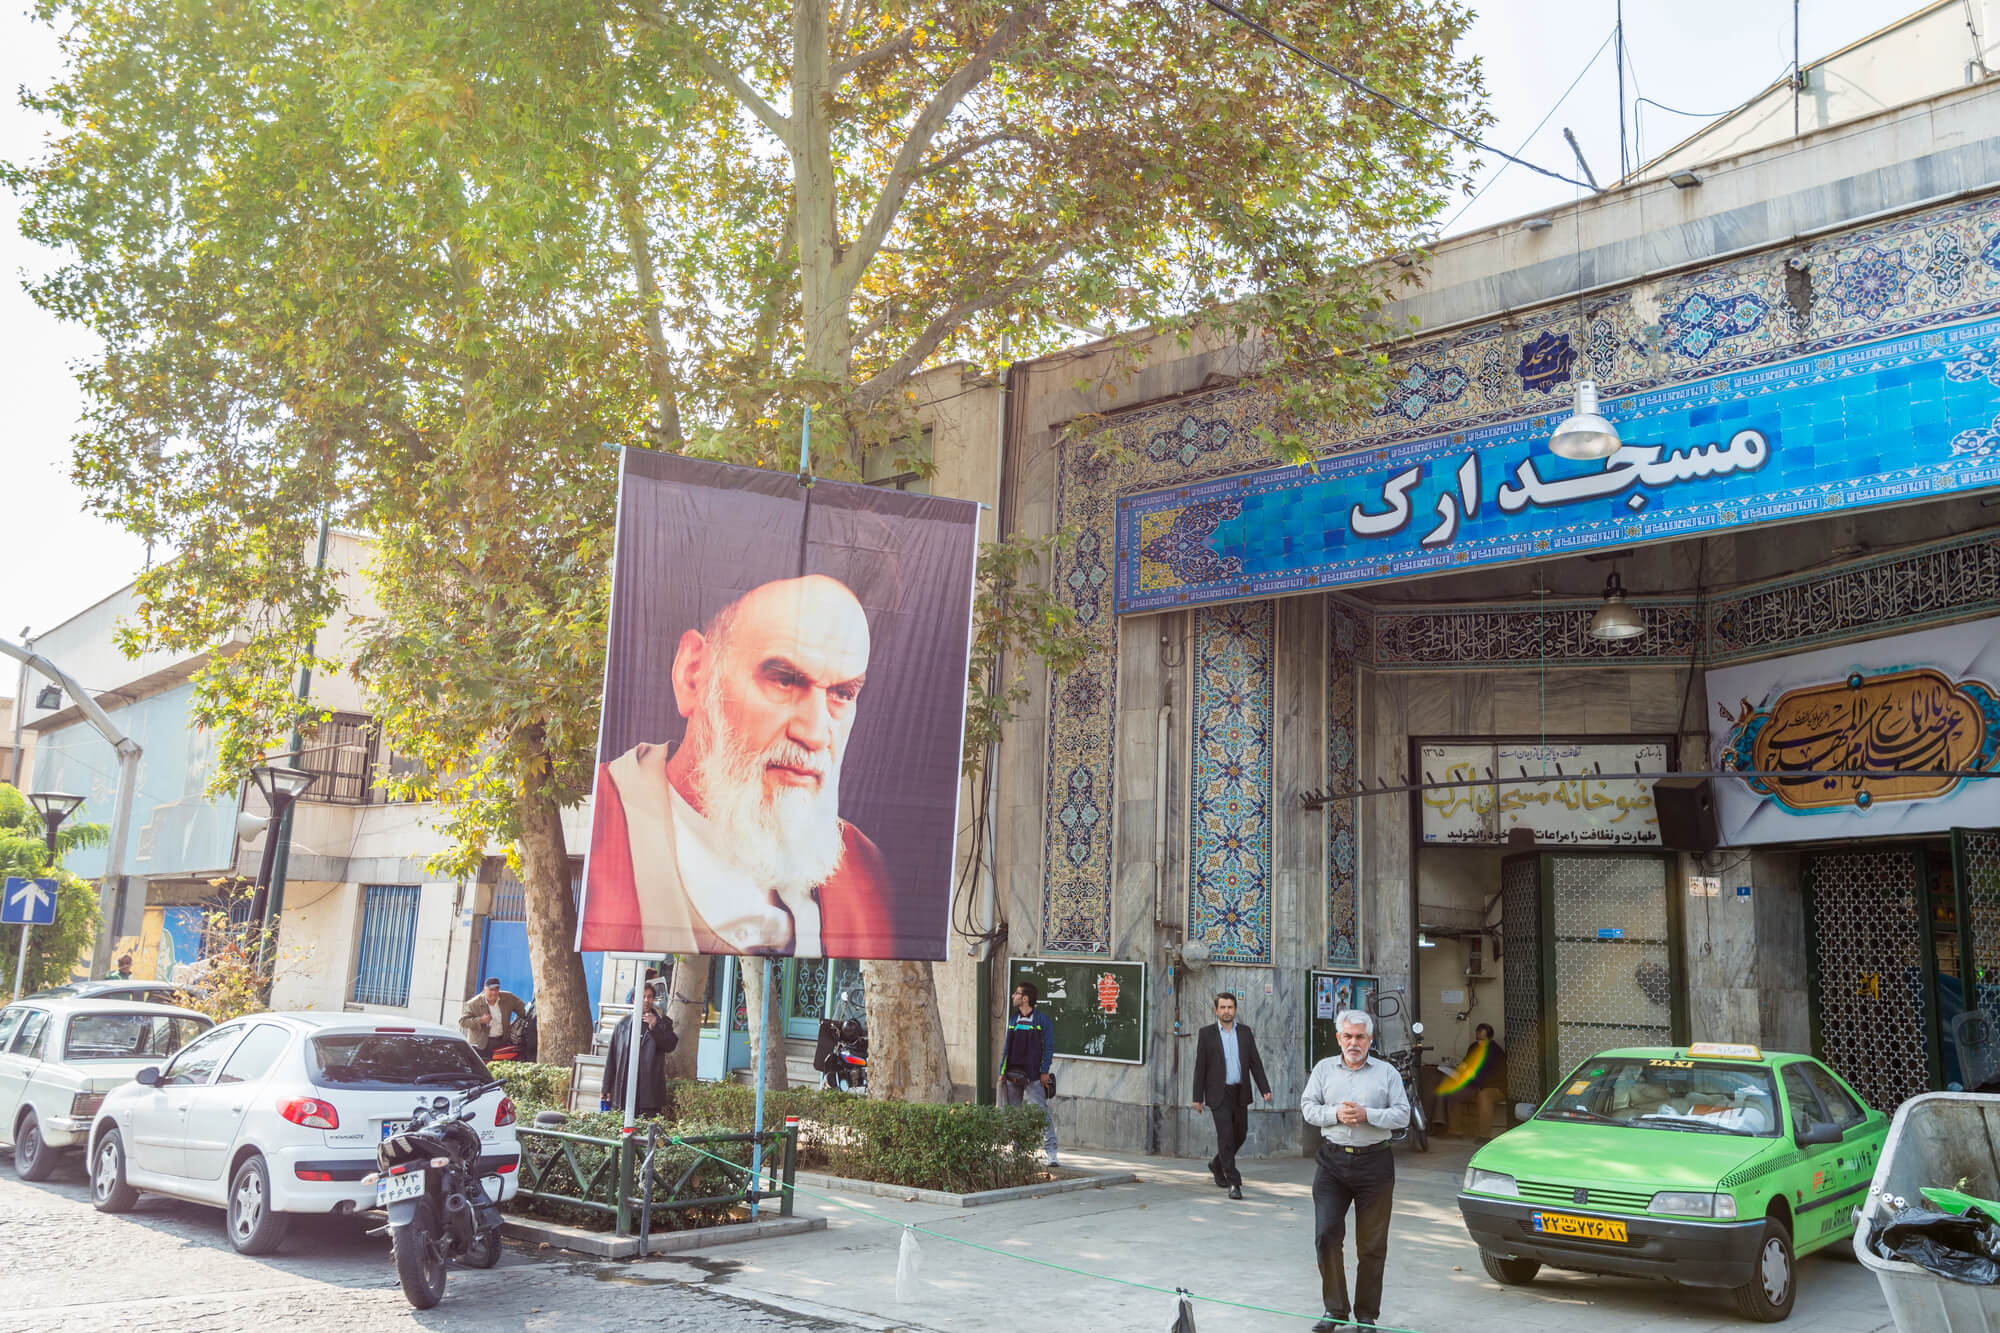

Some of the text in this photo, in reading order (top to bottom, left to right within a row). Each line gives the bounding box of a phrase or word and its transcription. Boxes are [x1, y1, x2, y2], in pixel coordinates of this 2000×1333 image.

[1350, 429, 1768, 547] مسجد ارک
[1649, 1059, 1695, 1068] TAXI
